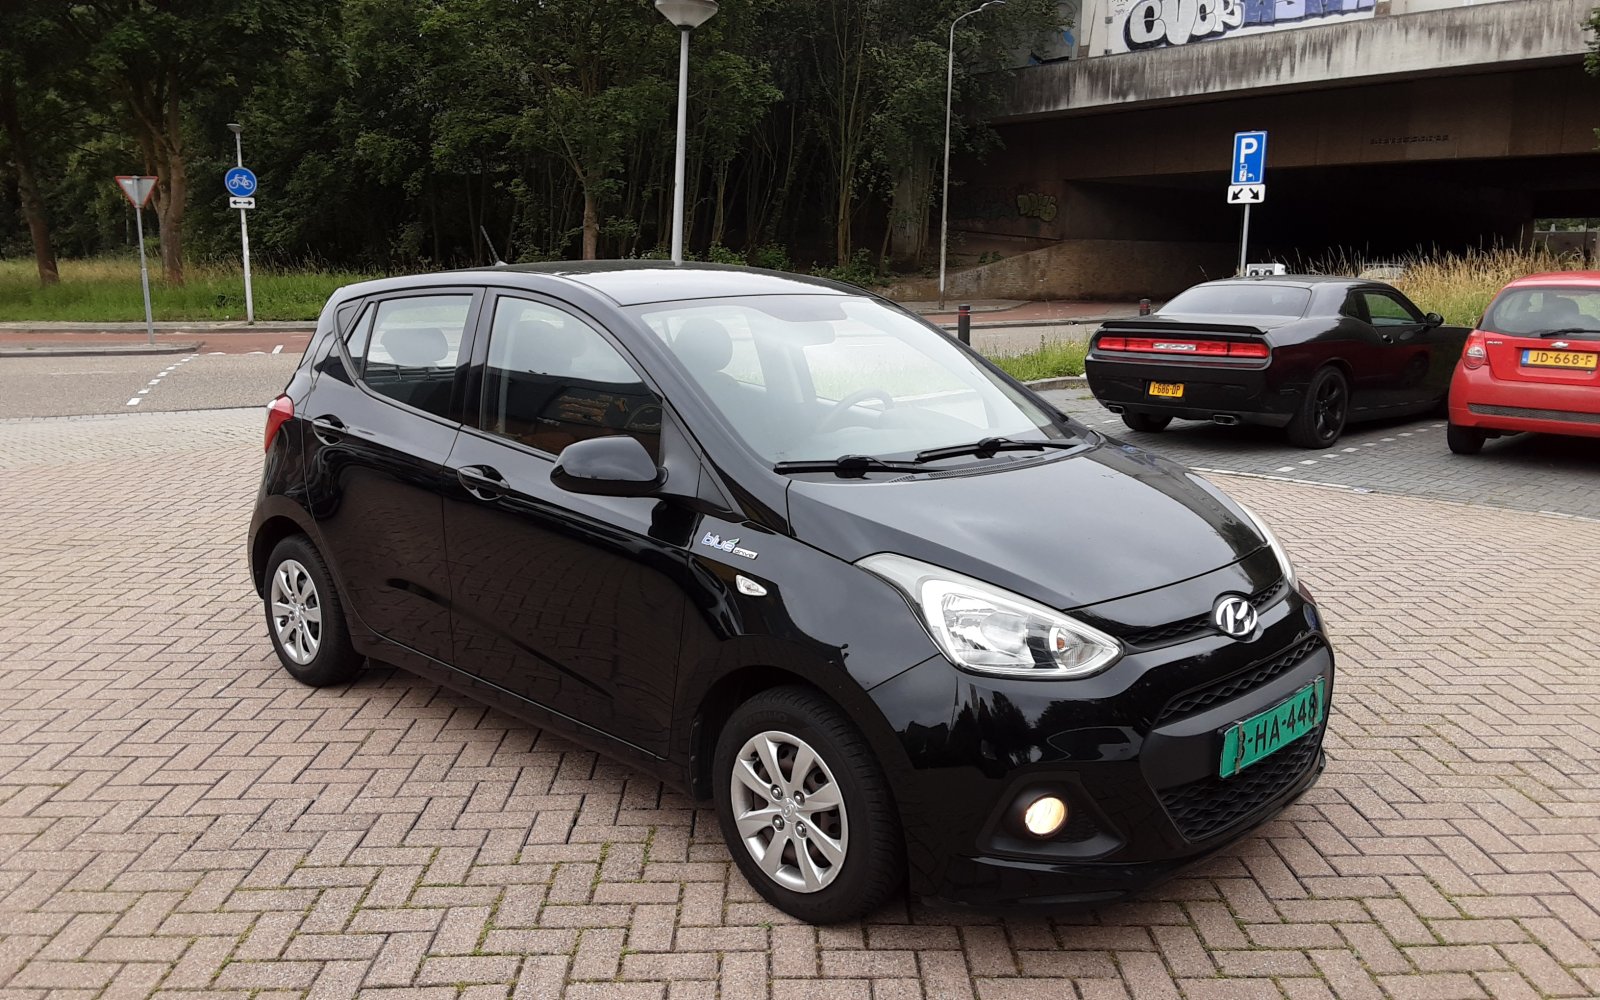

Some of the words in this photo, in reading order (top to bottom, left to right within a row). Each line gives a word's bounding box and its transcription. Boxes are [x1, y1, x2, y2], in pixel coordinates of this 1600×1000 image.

[1240, 137, 1258, 163] P
[1533, 352, 1593, 365] JD-668-F
[701, 531, 738, 553] blue
[734, 547, 756, 559] drive
